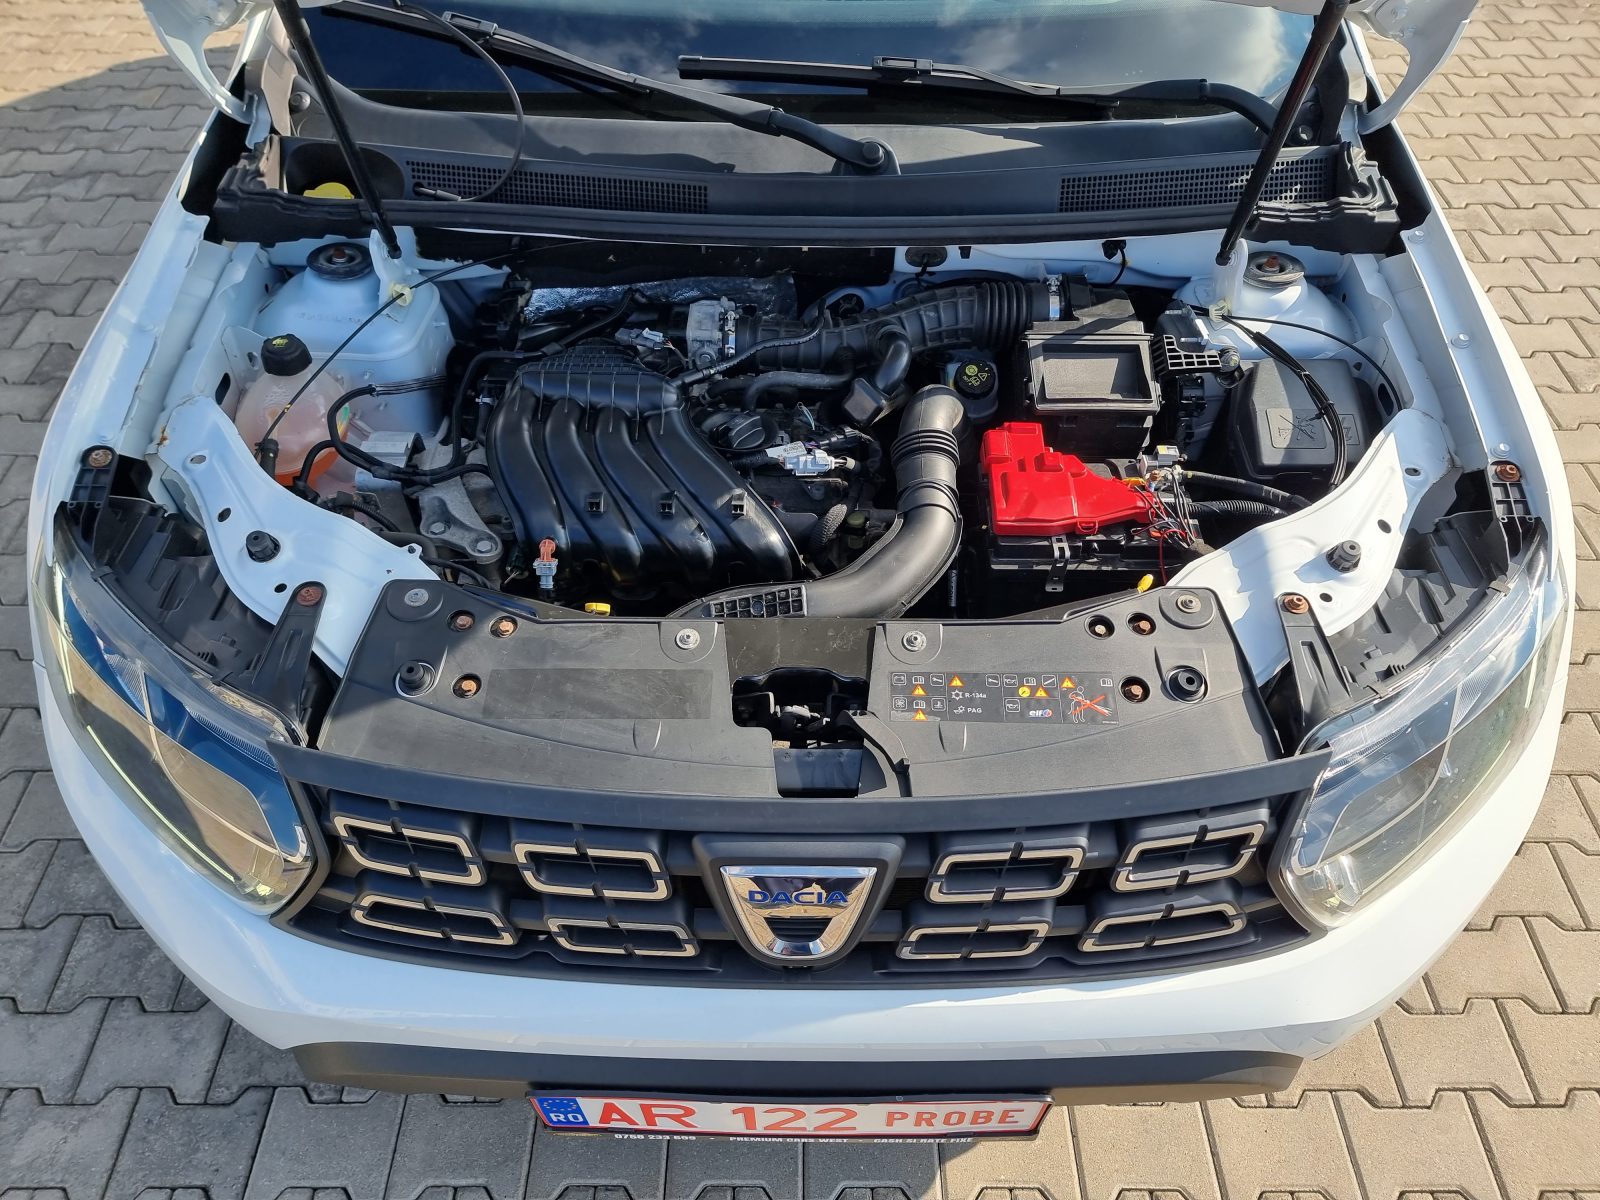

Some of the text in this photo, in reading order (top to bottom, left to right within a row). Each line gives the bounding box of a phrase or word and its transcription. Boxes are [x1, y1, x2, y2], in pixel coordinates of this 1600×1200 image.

[748, 890, 848, 904] DACIA
[549, 1112, 584, 1124] RO
[598, 1102, 1025, 1131] AR 122 PROBE
